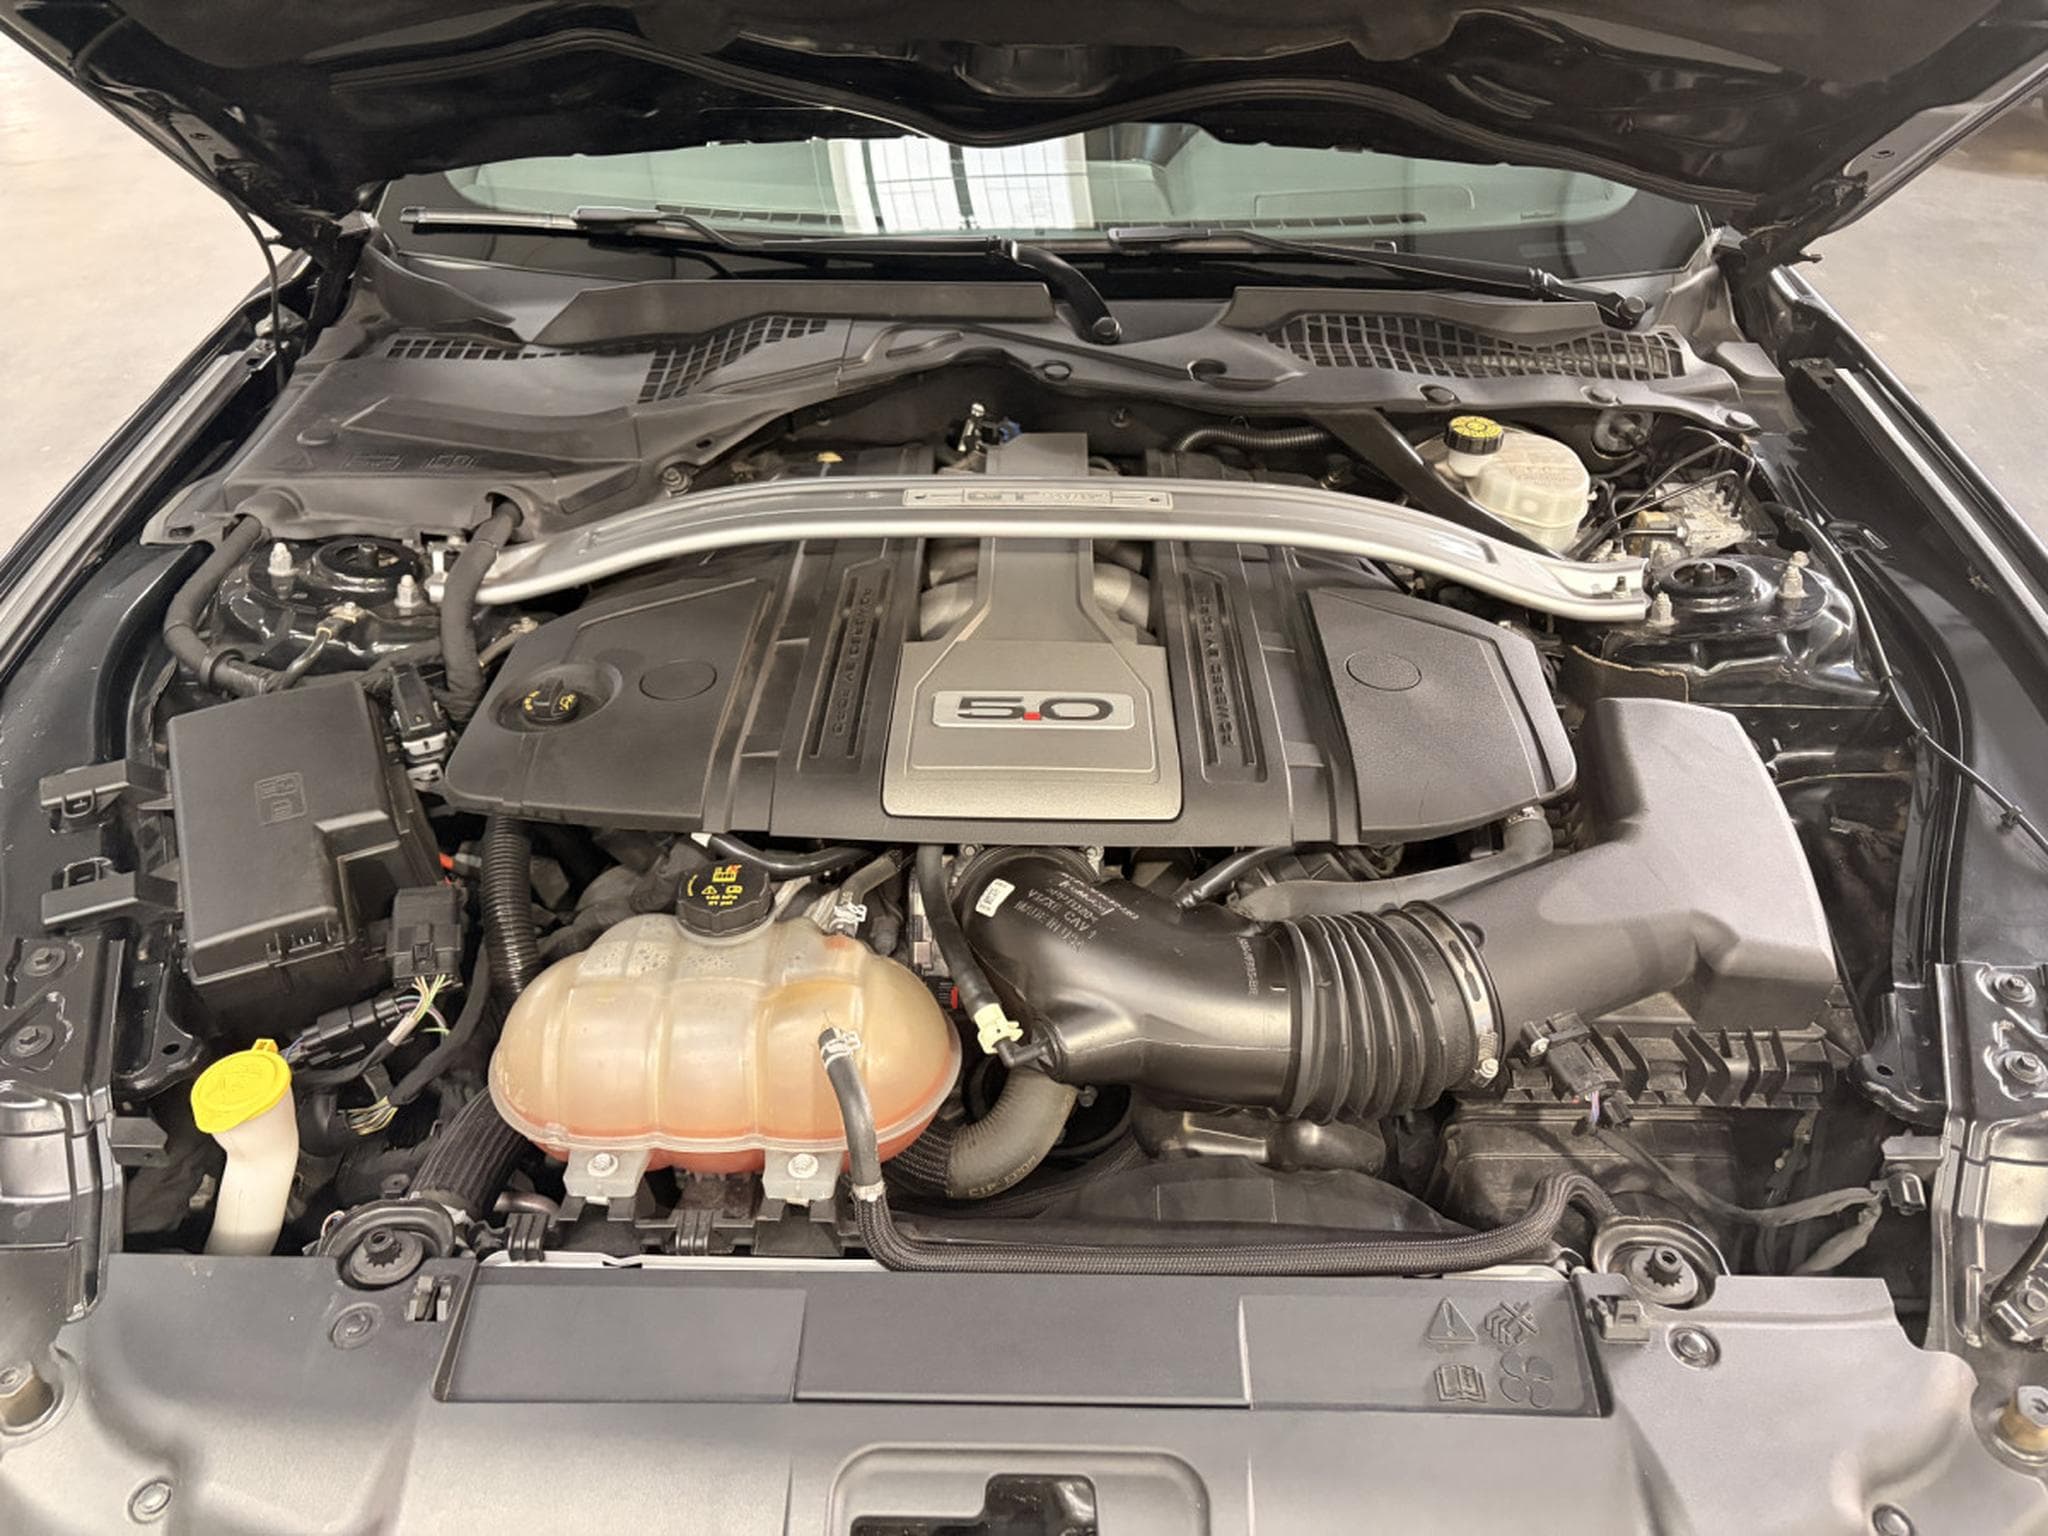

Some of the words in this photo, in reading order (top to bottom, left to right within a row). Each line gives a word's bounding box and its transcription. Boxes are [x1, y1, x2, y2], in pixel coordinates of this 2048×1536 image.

[957, 696, 1113, 721] 5.0
[1210, 664, 1235, 745] POWERED
[1045, 917, 1061, 933] IN
